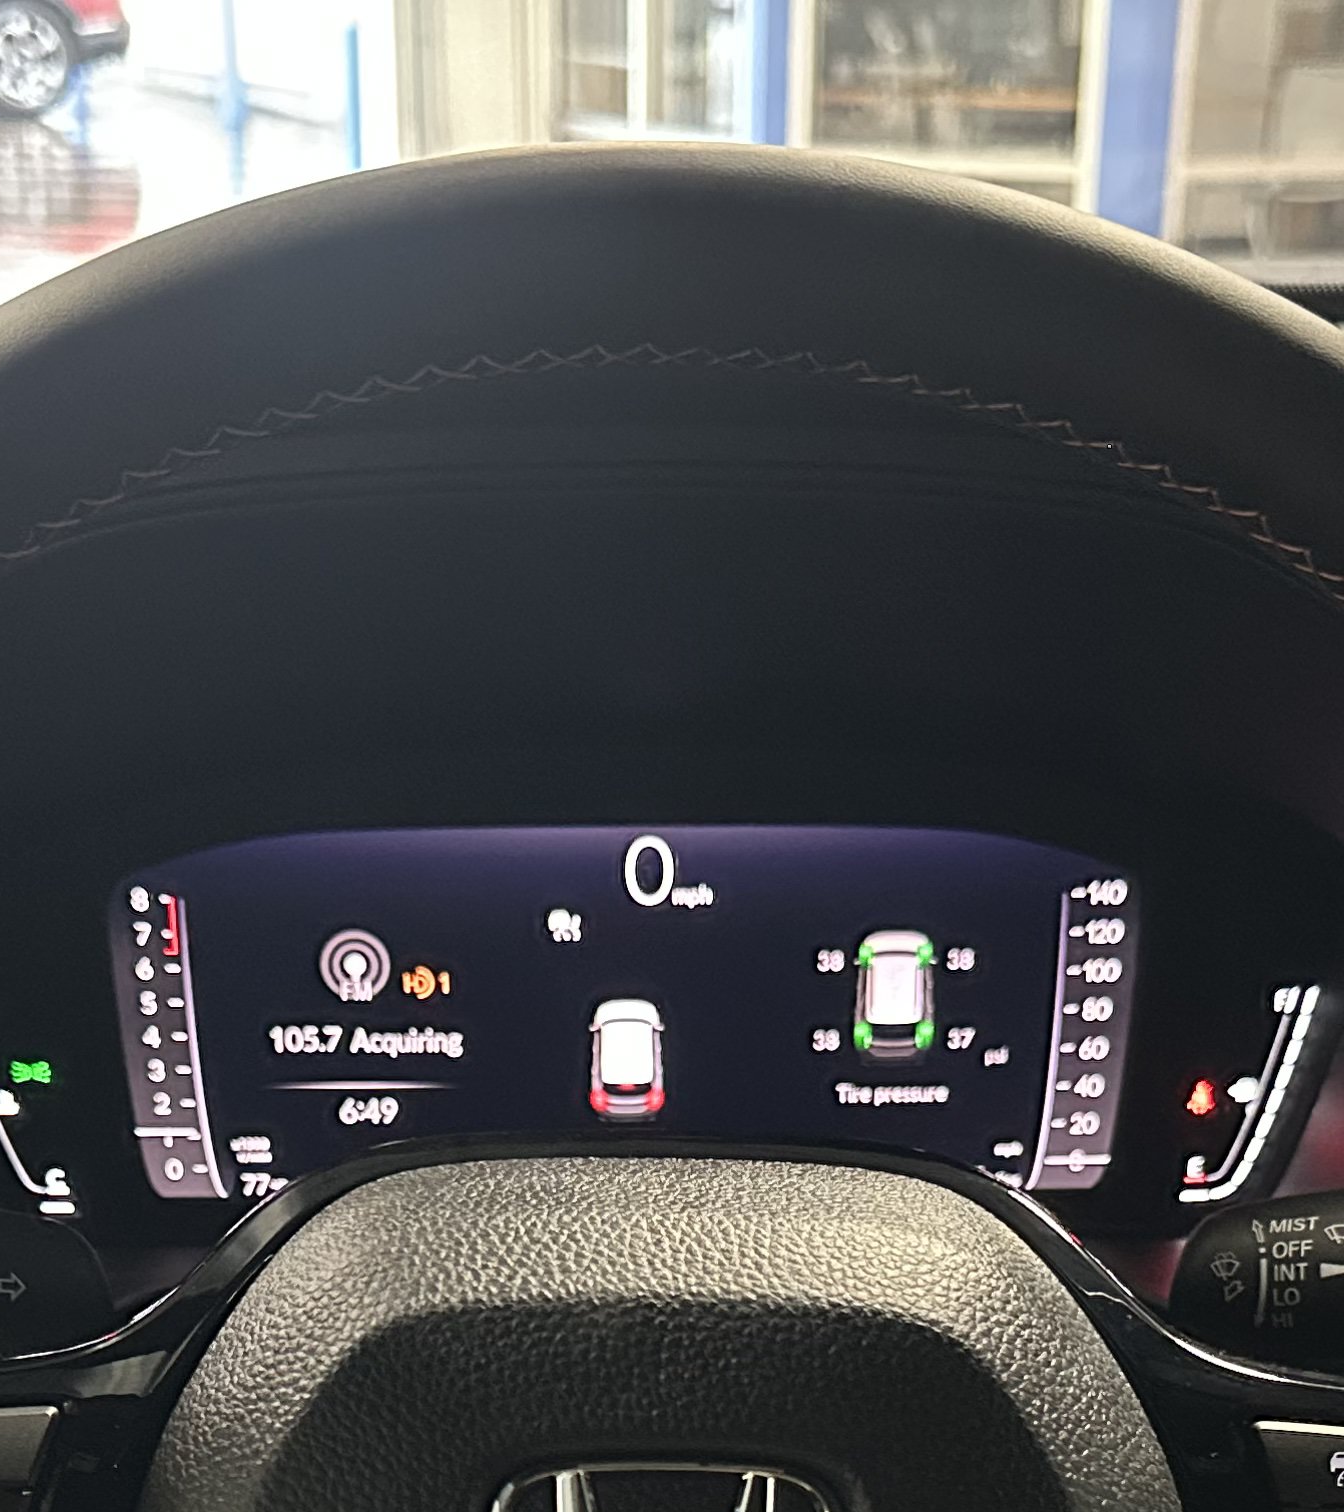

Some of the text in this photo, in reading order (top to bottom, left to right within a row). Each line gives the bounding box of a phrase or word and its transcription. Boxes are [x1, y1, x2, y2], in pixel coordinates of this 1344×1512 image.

[624, 834, 714, 909] 0 mph
[129, 886, 150, 912] 8
[1087, 879, 1128, 906] 140
[132, 921, 152, 947] 7
[1086, 918, 1126, 945] 120
[135, 956, 154, 981] 6
[1083, 957, 1122, 984] 100
[340, 980, 373, 1001] FM
[437, 971, 450, 994] 1
[139, 990, 157, 1016] 5
[1081, 996, 1114, 1021] 80
[141, 1025, 162, 1049] 4
[268, 1025, 465, 1058] 105.7 Acquiring
[947, 1026, 976, 1050] 37
[1078, 1035, 1110, 1061] 60
[146, 1058, 166, 1083] 3
[834, 1082, 950, 1107] Tire pressure
[1073, 1073, 1106, 1098] 40
[152, 1091, 172, 1116] 2
[338, 1096, 399, 1125] 6:49
[1068, 1111, 1101, 1136] 20
[164, 1157, 184, 1181] 0
[1268, 1215, 1320, 1233] MIST
[1272, 1240, 1314, 1259] OFF
[1273, 1263, 1308, 1282] INT
[1274, 1287, 1301, 1308] LO
[1272, 1312, 1295, 1329] HI
